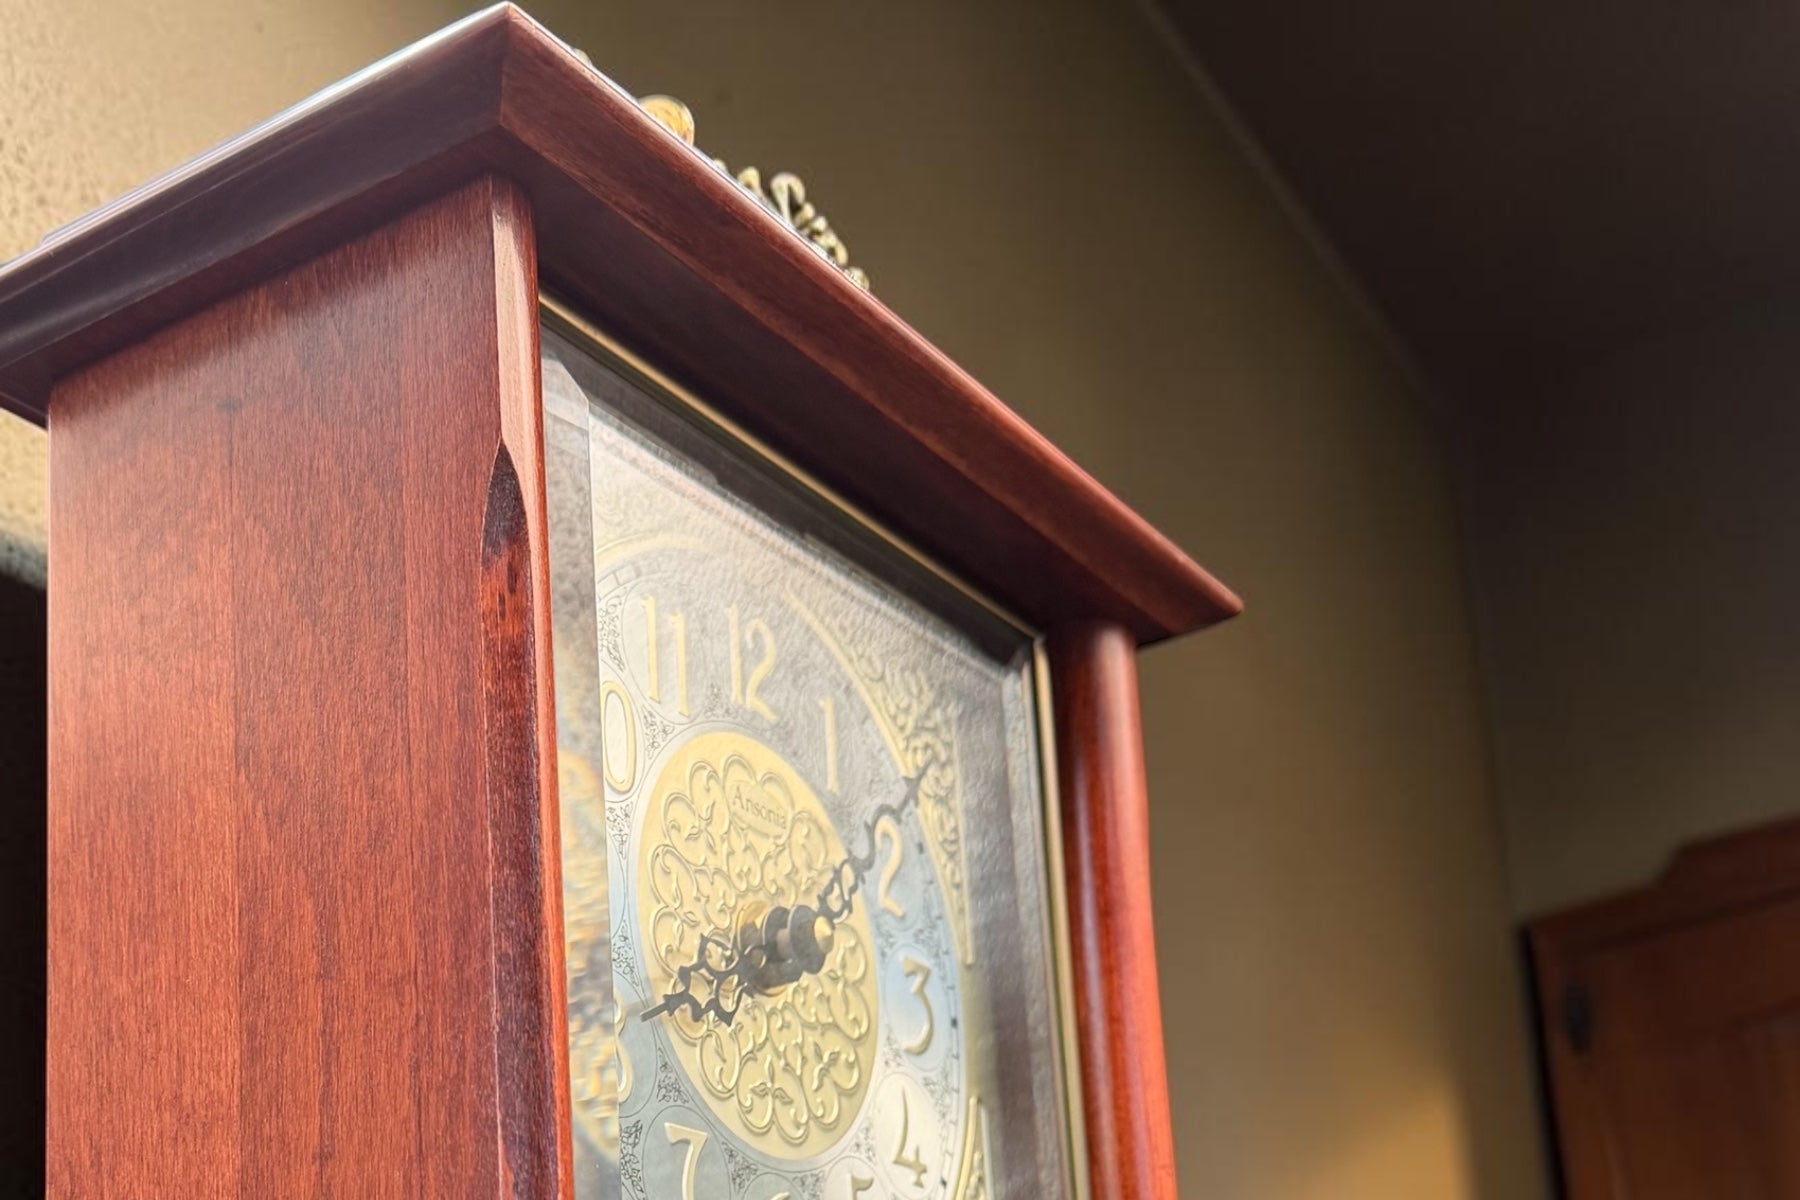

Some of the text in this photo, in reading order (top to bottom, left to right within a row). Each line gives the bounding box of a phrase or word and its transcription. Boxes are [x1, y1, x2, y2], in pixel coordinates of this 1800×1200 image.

[641, 593, 691, 718] 11
[727, 603, 779, 724] 12
[602, 680, 636, 793] 0
[819, 697, 840, 796] 1
[874, 815, 906, 920] 2
[902, 956, 934, 1057] 3
[893, 1086, 928, 1189] 4
